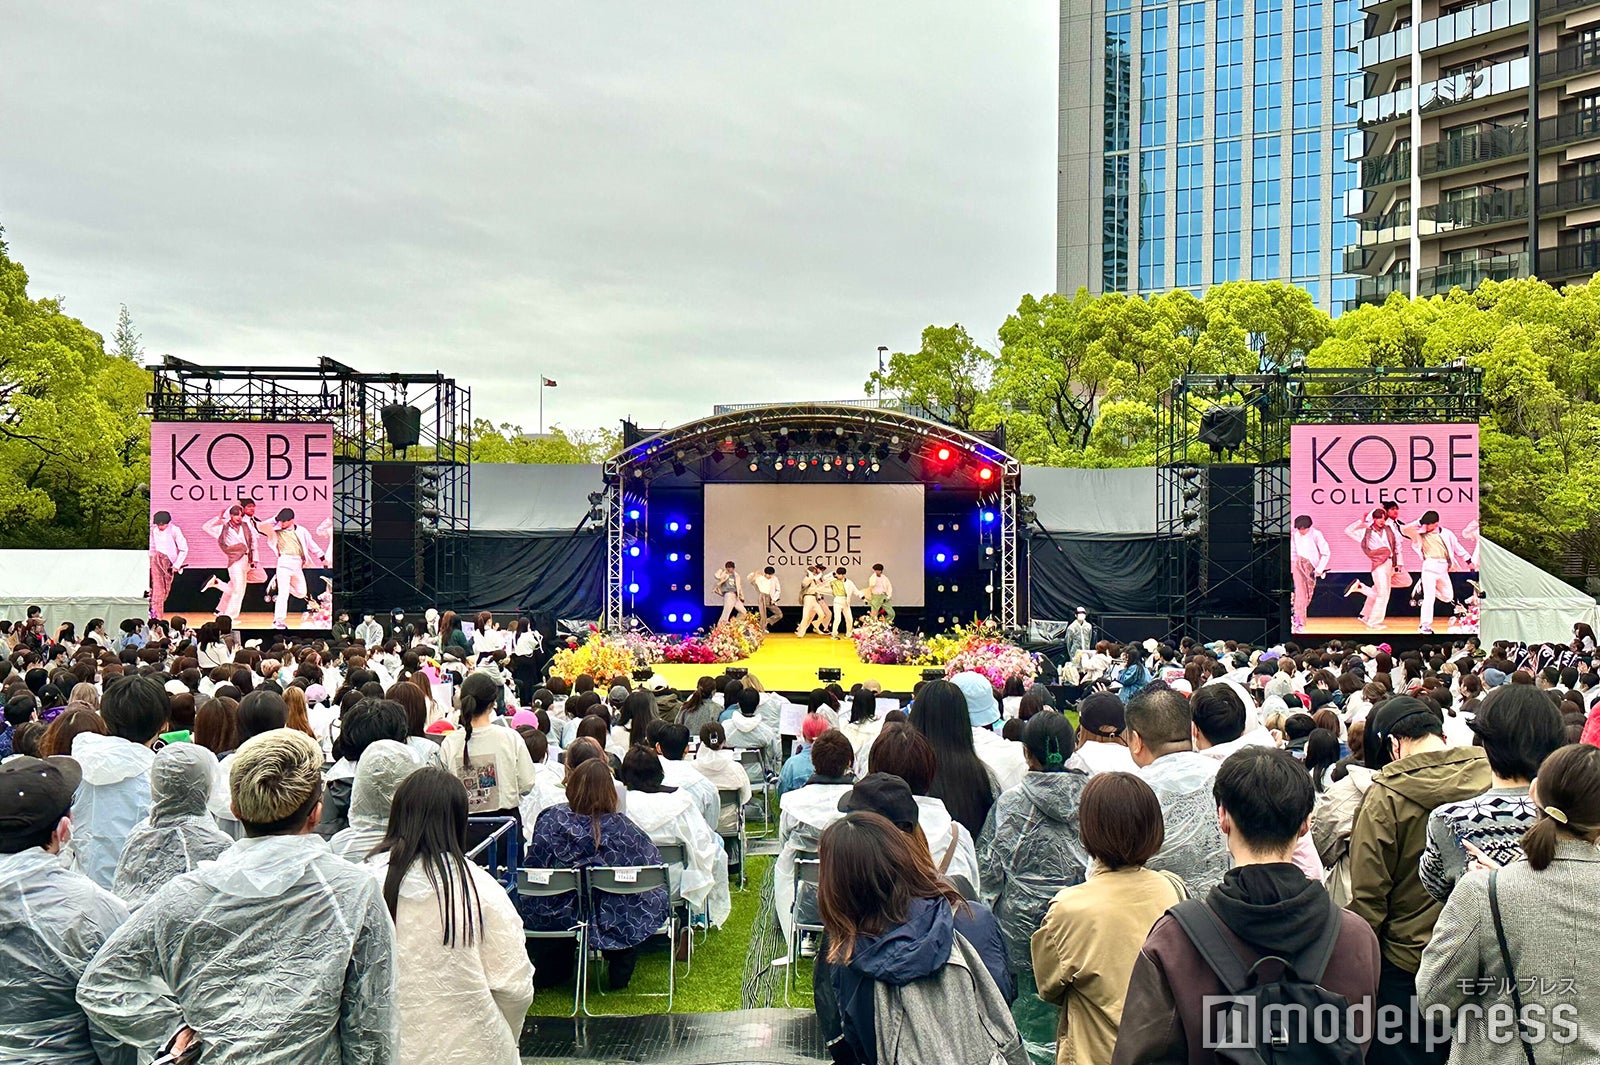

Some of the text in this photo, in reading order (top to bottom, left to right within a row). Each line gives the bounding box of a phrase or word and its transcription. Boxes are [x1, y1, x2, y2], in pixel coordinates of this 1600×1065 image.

[171, 432, 328, 482] KOBE
[1311, 434, 1473, 485] KOBE
[170, 484, 328, 501] COLLECTION
[1311, 486, 1474, 504] COLLECTION
[767, 524, 862, 555] KOBE
[766, 555, 862, 567] COLLECTION
